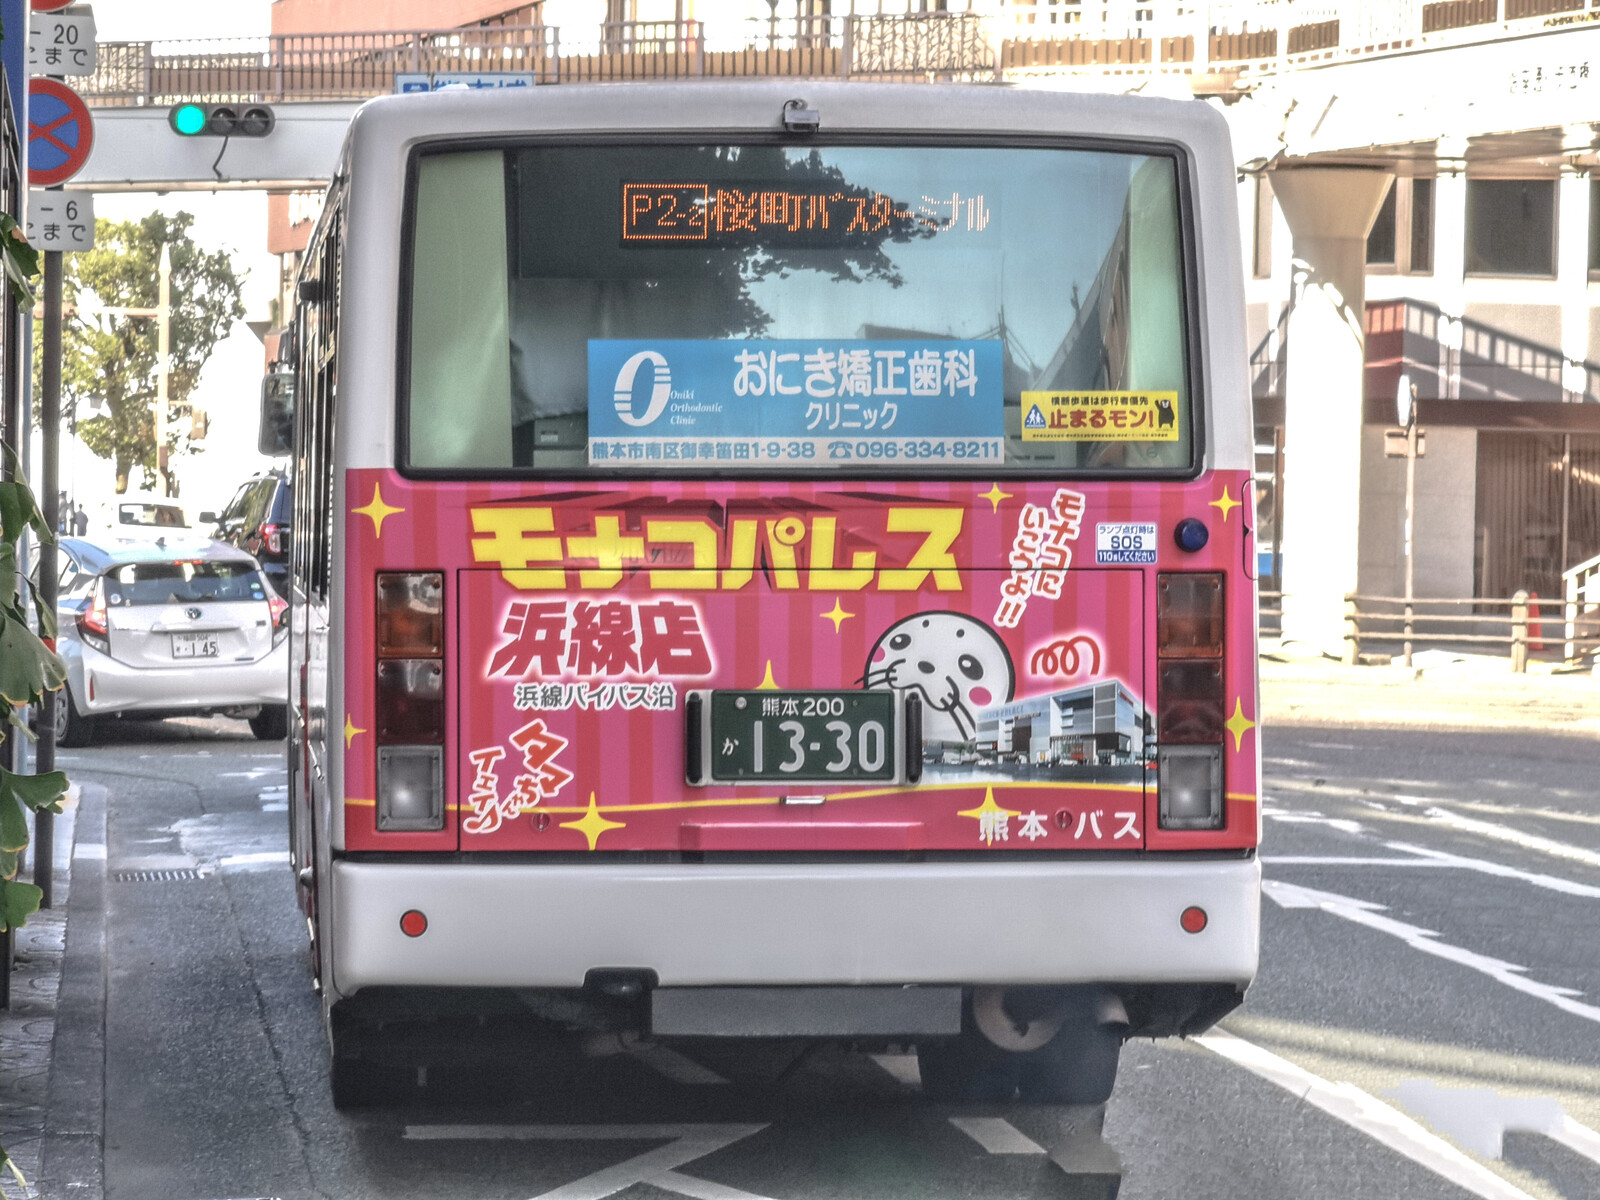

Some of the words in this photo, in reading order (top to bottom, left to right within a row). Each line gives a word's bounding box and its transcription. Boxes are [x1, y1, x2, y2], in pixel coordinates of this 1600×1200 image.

[710, 188, 990, 232] 桜町バスターミナル
[732, 347, 979, 398] おにき矯正歯科
[670, 389, 695, 400] Oniki
[670, 402, 723, 413] Orthodontic
[670, 415, 696, 425] Clinic
[804, 400, 899, 431] クリニック
[1048, 408, 1154, 429] 止まるモン!
[855, 441, 999, 460] 096-334-8211
[469, 506, 965, 591] モナコパレス
[1110, 535, 1143, 550] SOS
[486, 600, 714, 678] 浜線店
[515, 683, 675, 709] 浜線バイパス沿
[721, 737, 740, 756] か
[752, 719, 886, 774] 13-30
